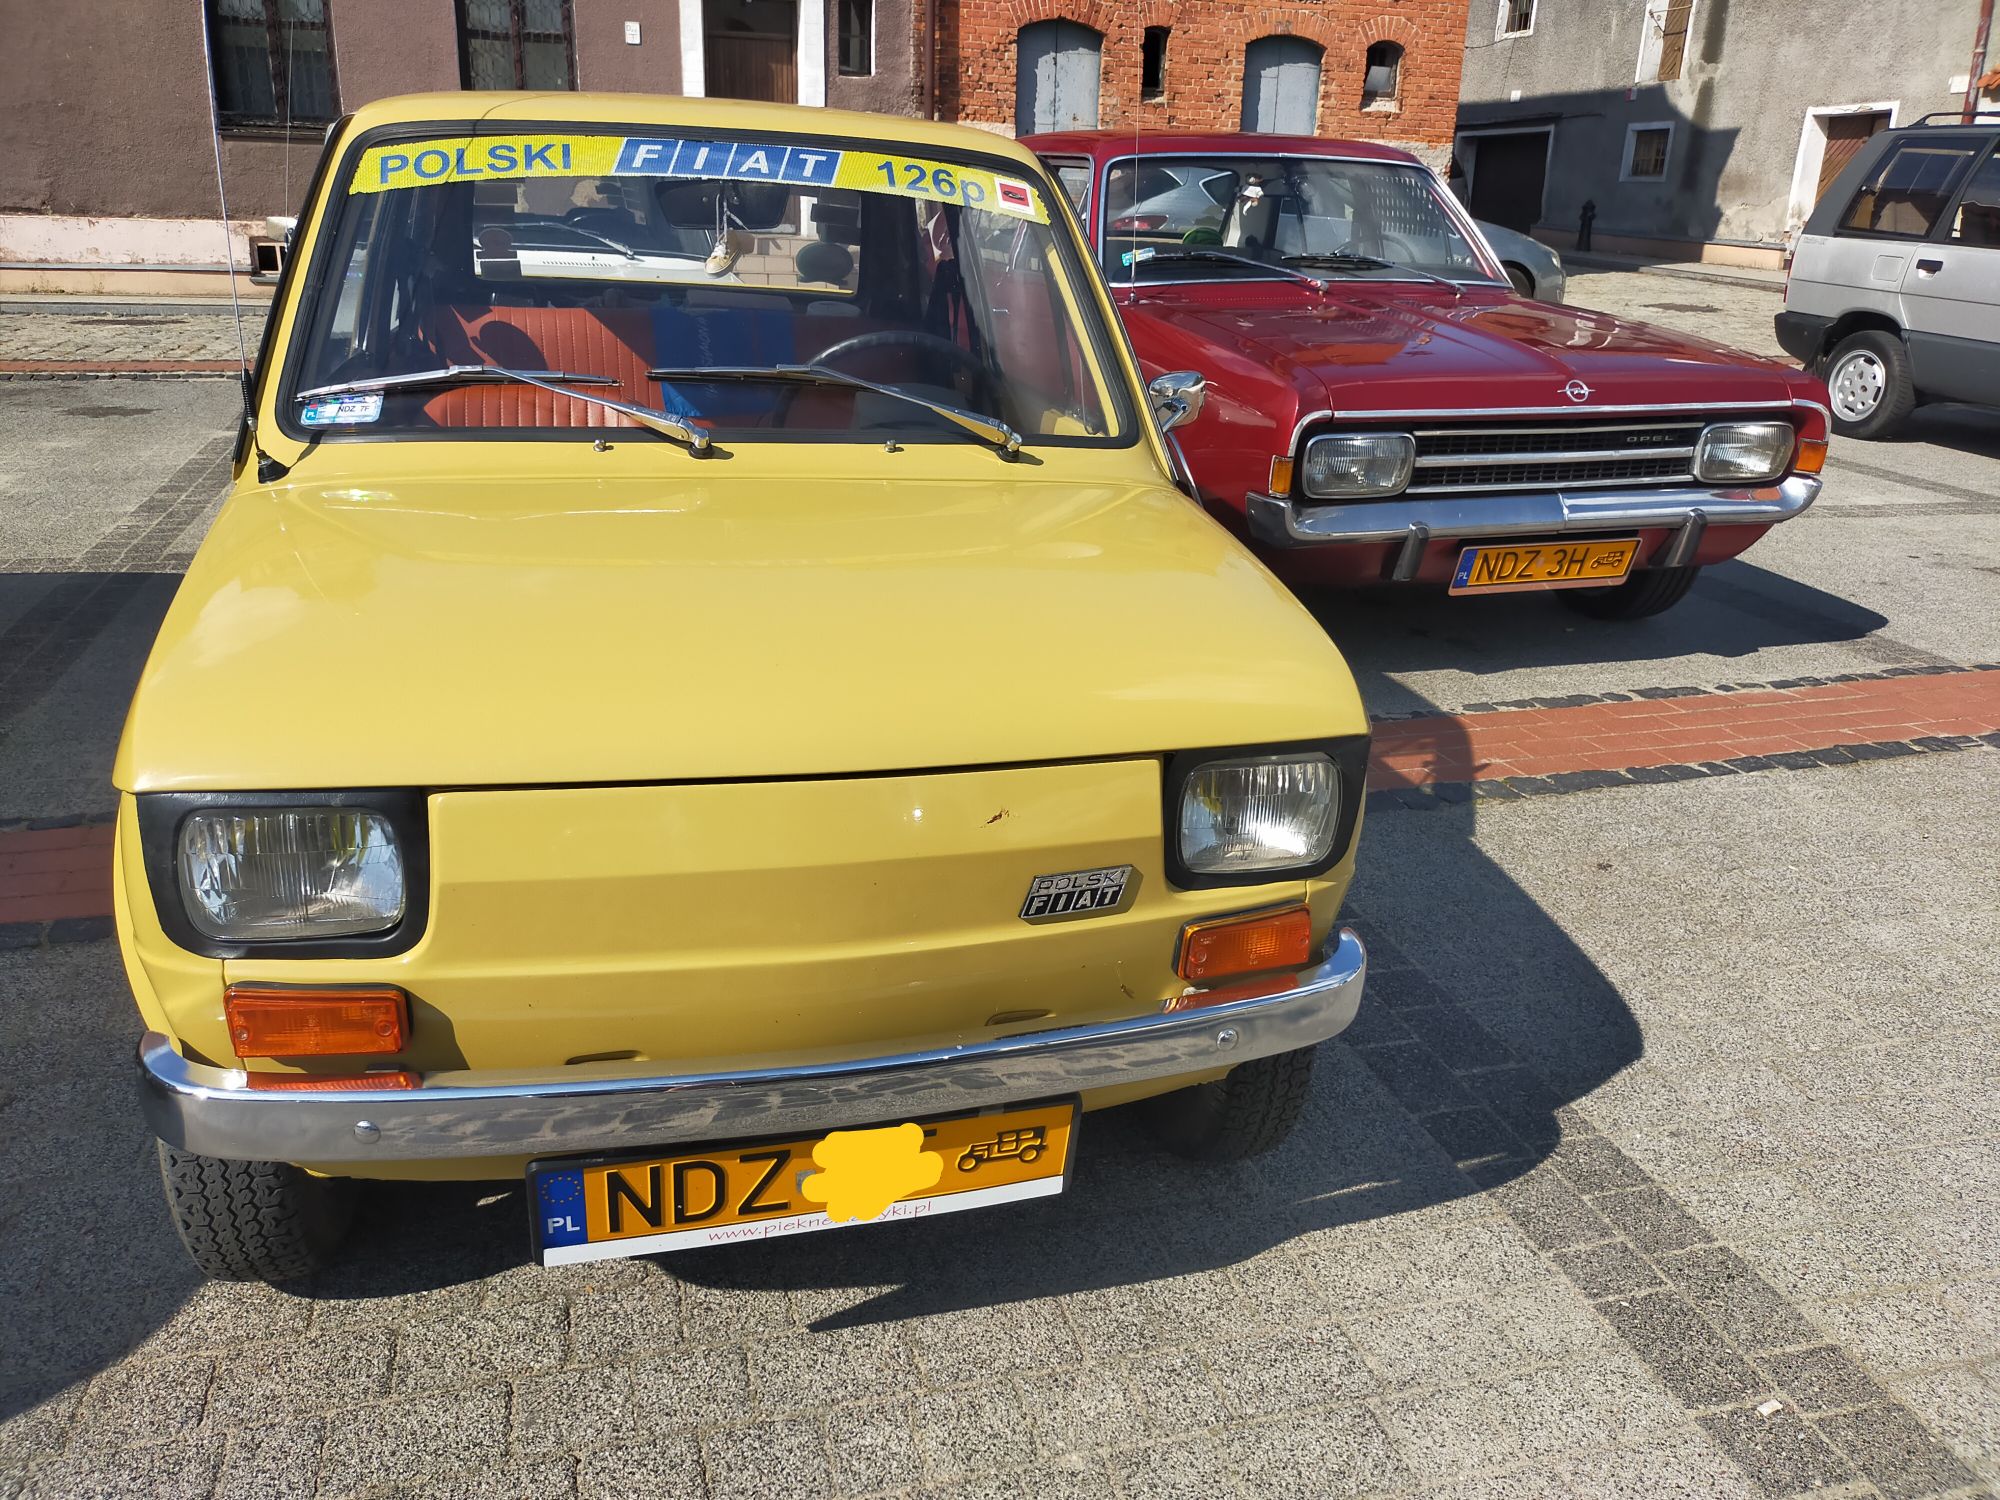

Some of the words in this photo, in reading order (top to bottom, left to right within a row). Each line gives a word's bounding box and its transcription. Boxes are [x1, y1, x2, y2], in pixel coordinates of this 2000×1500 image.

[379, 143, 571, 185] POLSKI
[630, 144, 828, 178] FIAT
[877, 160, 986, 208] 126p
[337, 404, 356, 413] NDZ
[1626, 435, 1675, 443] OPEL
[1457, 571, 1469, 581] PL
[1474, 550, 1541, 583] NDZ
[1546, 547, 1590, 577] 3H
[1035, 869, 1126, 894] POLSKI
[1027, 885, 1120, 916] FIAT
[605, 1149, 792, 1234] NDZ
[547, 1215, 581, 1234] PL
